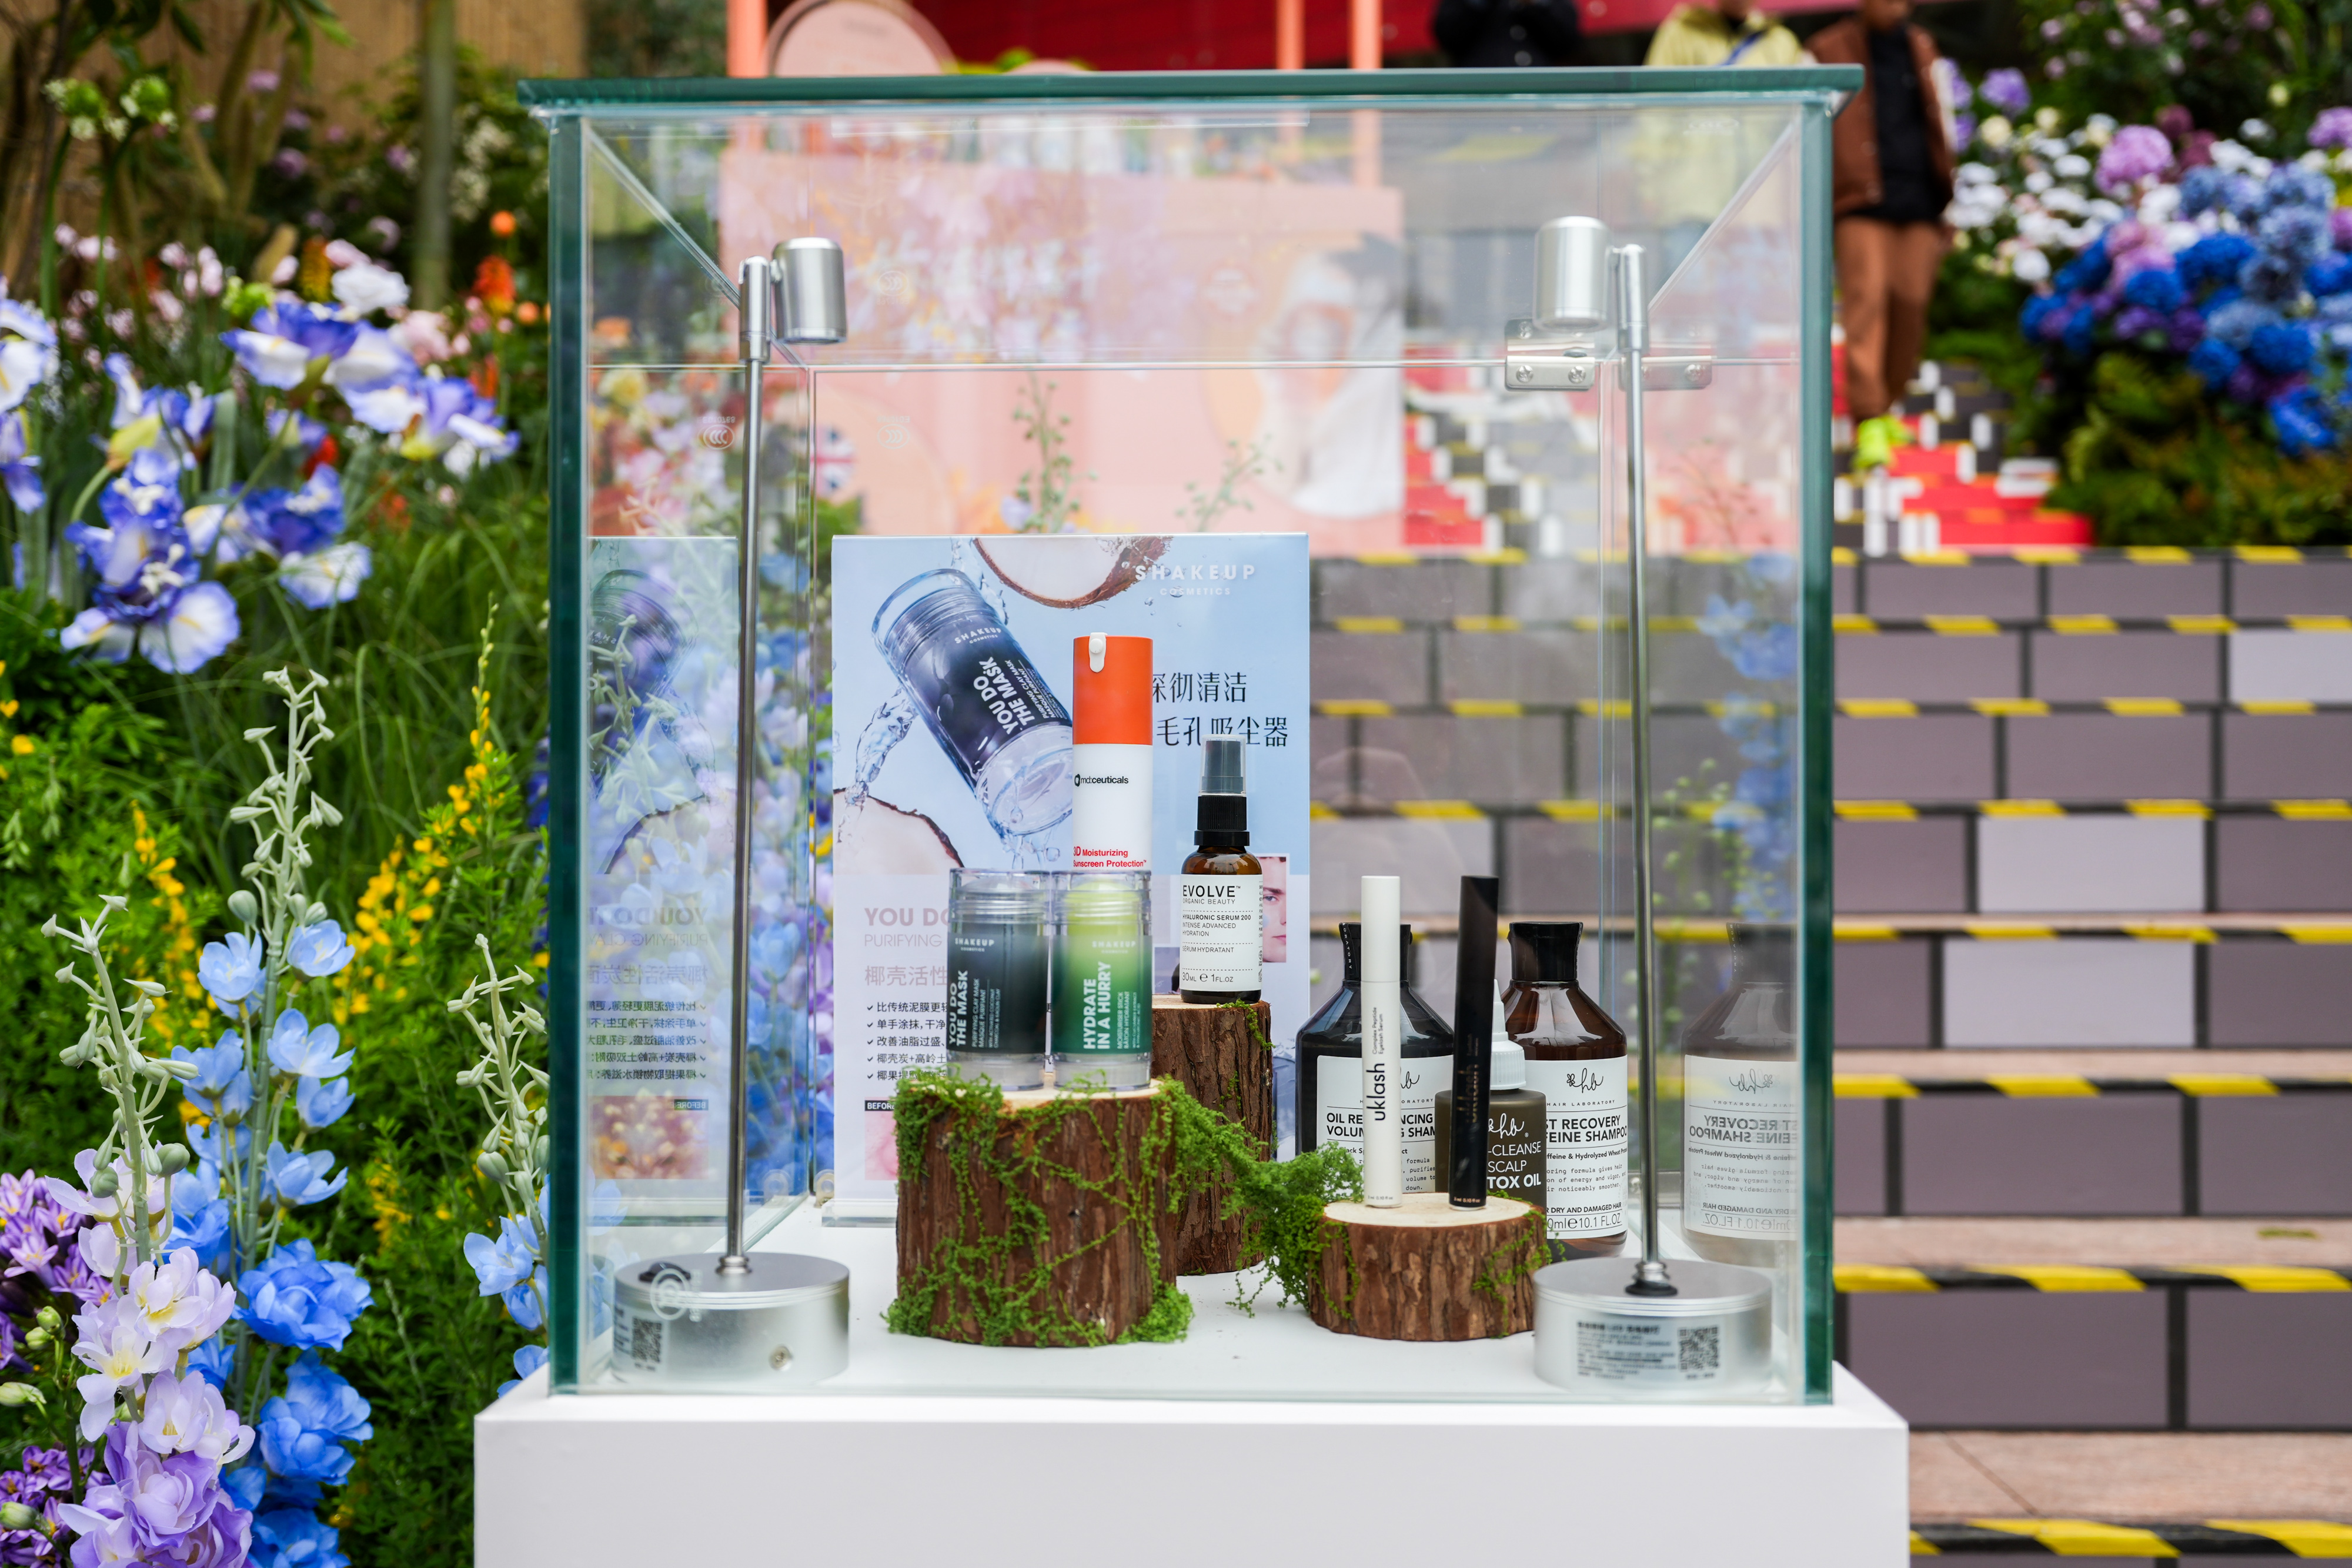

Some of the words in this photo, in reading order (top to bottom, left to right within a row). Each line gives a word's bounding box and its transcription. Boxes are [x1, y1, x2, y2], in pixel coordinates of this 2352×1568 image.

[1135, 565, 1255, 580] SHAKEUP
[954, 627, 1001, 644] SHAKEUP
[969, 634, 998, 644] COSMETICS
[1005, 660, 1020, 676] MASK
[979, 657, 1017, 698] MASK
[1015, 674, 1028, 689] CLAY
[1018, 668, 1039, 694] PURIFIANT
[974, 676, 997, 701] DO
[1008, 698, 1035, 726] THE
[1027, 691, 1050, 718] PURIFYING
[1036, 693, 1055, 717] MASQUE
[988, 700, 1018, 734] YOU
[1074, 846, 1081, 856] 3D
[1083, 849, 1128, 858] Moisturizing
[864, 908, 913, 926] YOU
[865, 934, 942, 947] PURIFYING
[955, 938, 994, 947] SHAKEUP
[865, 965, 947, 986] 椰壳活性
[1182, 972, 1197, 982] 30ML
[950, 982, 957, 1007] DO
[957, 970, 968, 1015] MASK
[1098, 961, 1111, 1013] HURRY
[1084, 979, 1097, 1049] HYDRATE
[949, 1012, 957, 1044] YOU
[1097, 1017, 1110, 1029] A
[957, 1019, 966, 1047] THE
[1097, 1034, 1110, 1049] IN
[1366, 1063, 1386, 1121] uklash
[1327, 1113, 1345, 1124] OIL
[1348, 1114, 1433, 1124] RENCING
[1562, 1115, 1621, 1129] RECOVERY
[1408, 1126, 1435, 1137] SHAM
[1585, 1125, 1627, 1142] SHAMPOO
[1488, 1141, 1541, 1156] -CLEANSE
[1576, 1151, 1607, 1161] Hydrolyzed
[1488, 1160, 1527, 1172] SCALP
[1486, 1176, 1520, 1189] TOX
[1524, 1173, 1541, 1188] OIL
[1583, 1204, 1612, 1213] DAMAGED
[1547, 1218, 1566, 1229] 0ml
